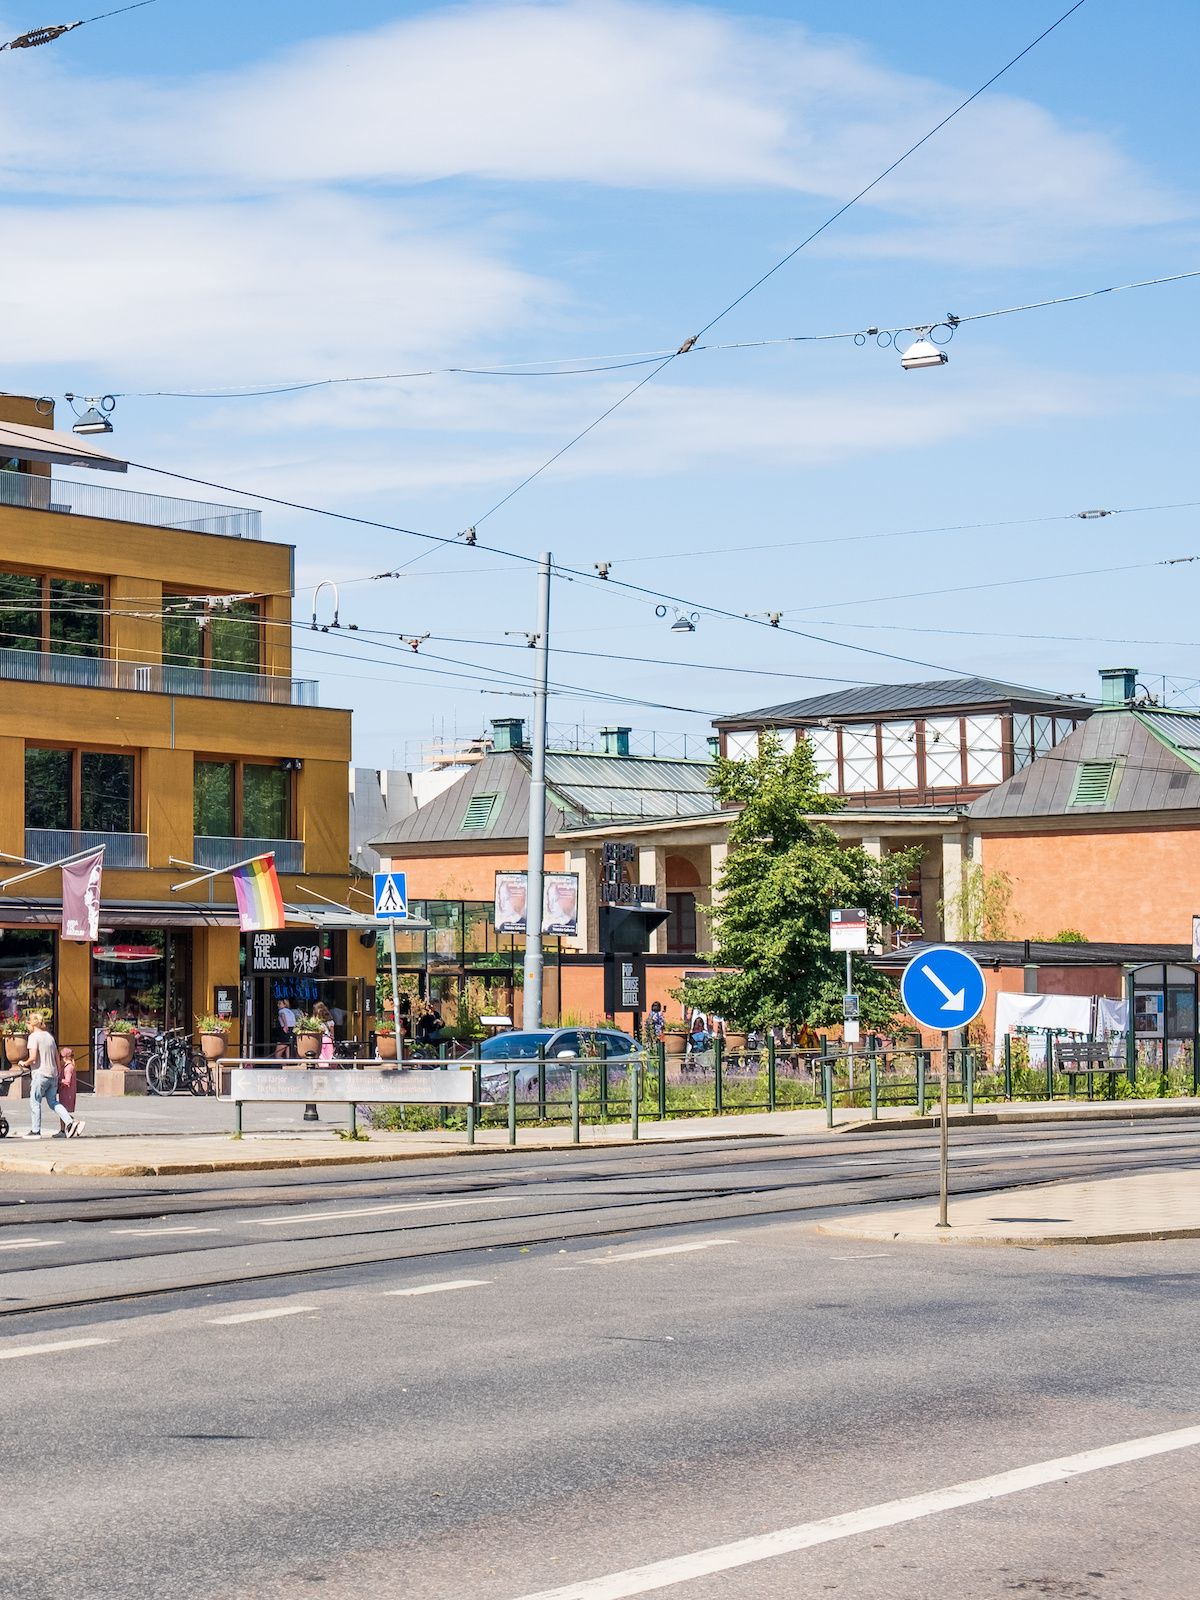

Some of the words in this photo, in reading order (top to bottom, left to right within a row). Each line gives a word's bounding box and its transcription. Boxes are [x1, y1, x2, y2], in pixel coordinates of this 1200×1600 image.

[254, 934, 276, 946] ABBA
[254, 946, 270, 957] THE
[254, 957, 290, 969] MUSEUM
